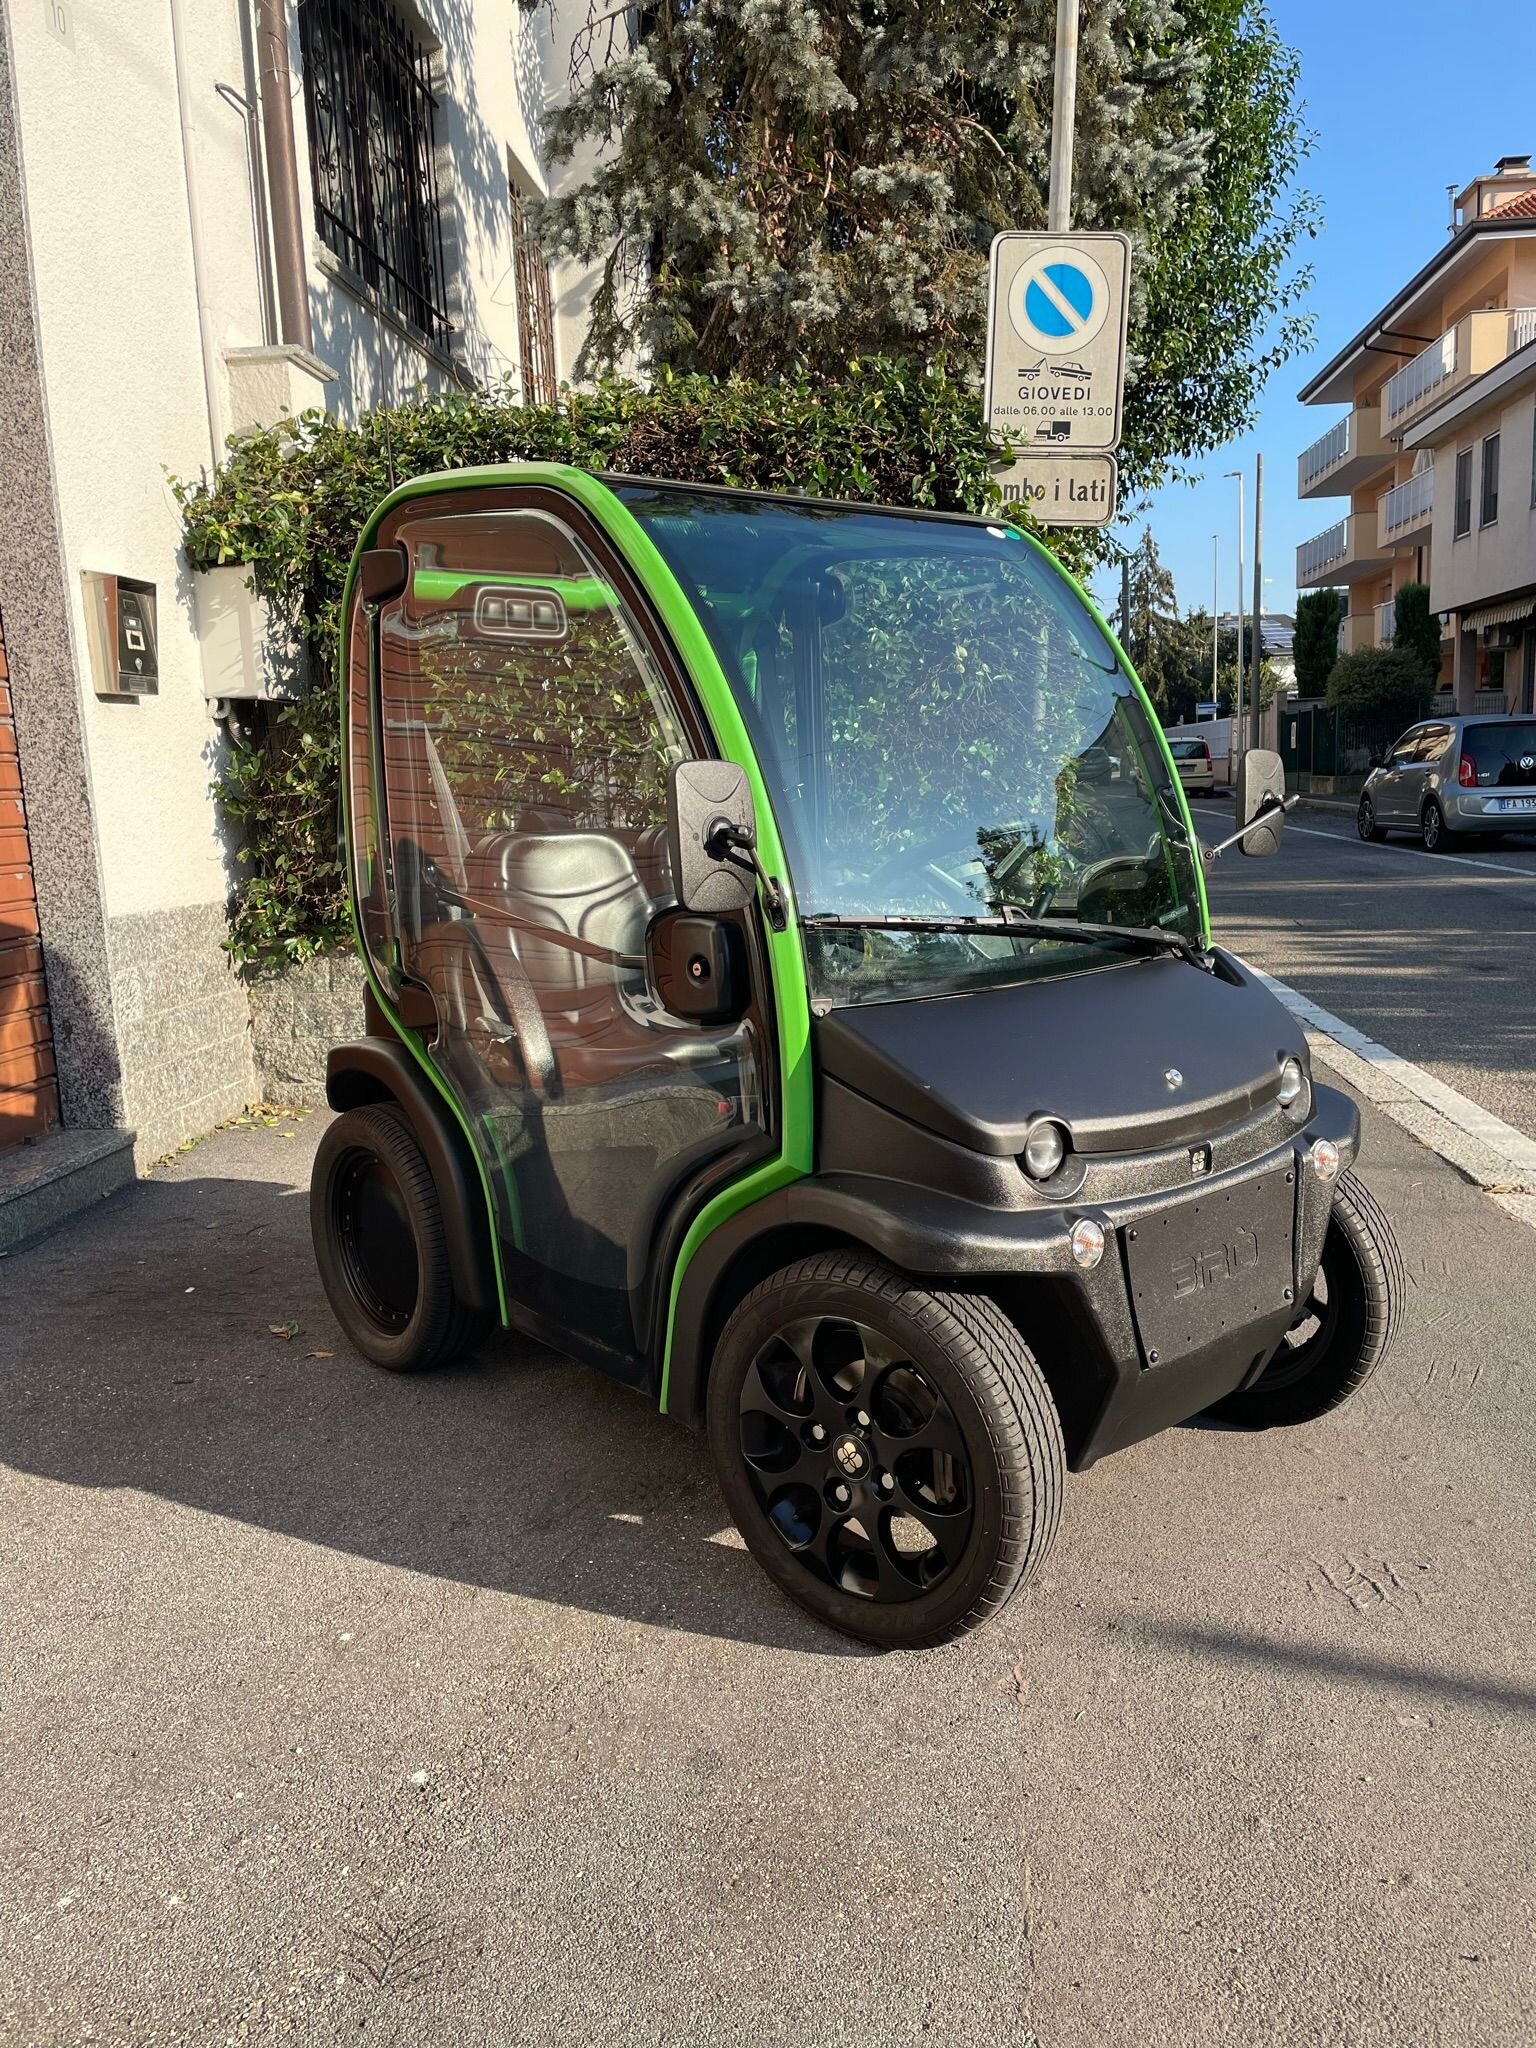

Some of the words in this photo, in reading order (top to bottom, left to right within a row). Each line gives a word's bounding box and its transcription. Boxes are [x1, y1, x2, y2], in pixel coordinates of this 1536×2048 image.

[51, 0, 66, 35] 10
[1018, 386, 1091, 401] GIOVEDI
[993, 406, 1020, 415] dalle
[1023, 406, 1056, 416] 06.00
[1060, 407, 1078, 416] alle
[1083, 407, 1113, 417] 13.00
[1003, 477, 1046, 501] mbo
[1054, 478, 1060, 502] i
[1069, 478, 1106, 502] lati
